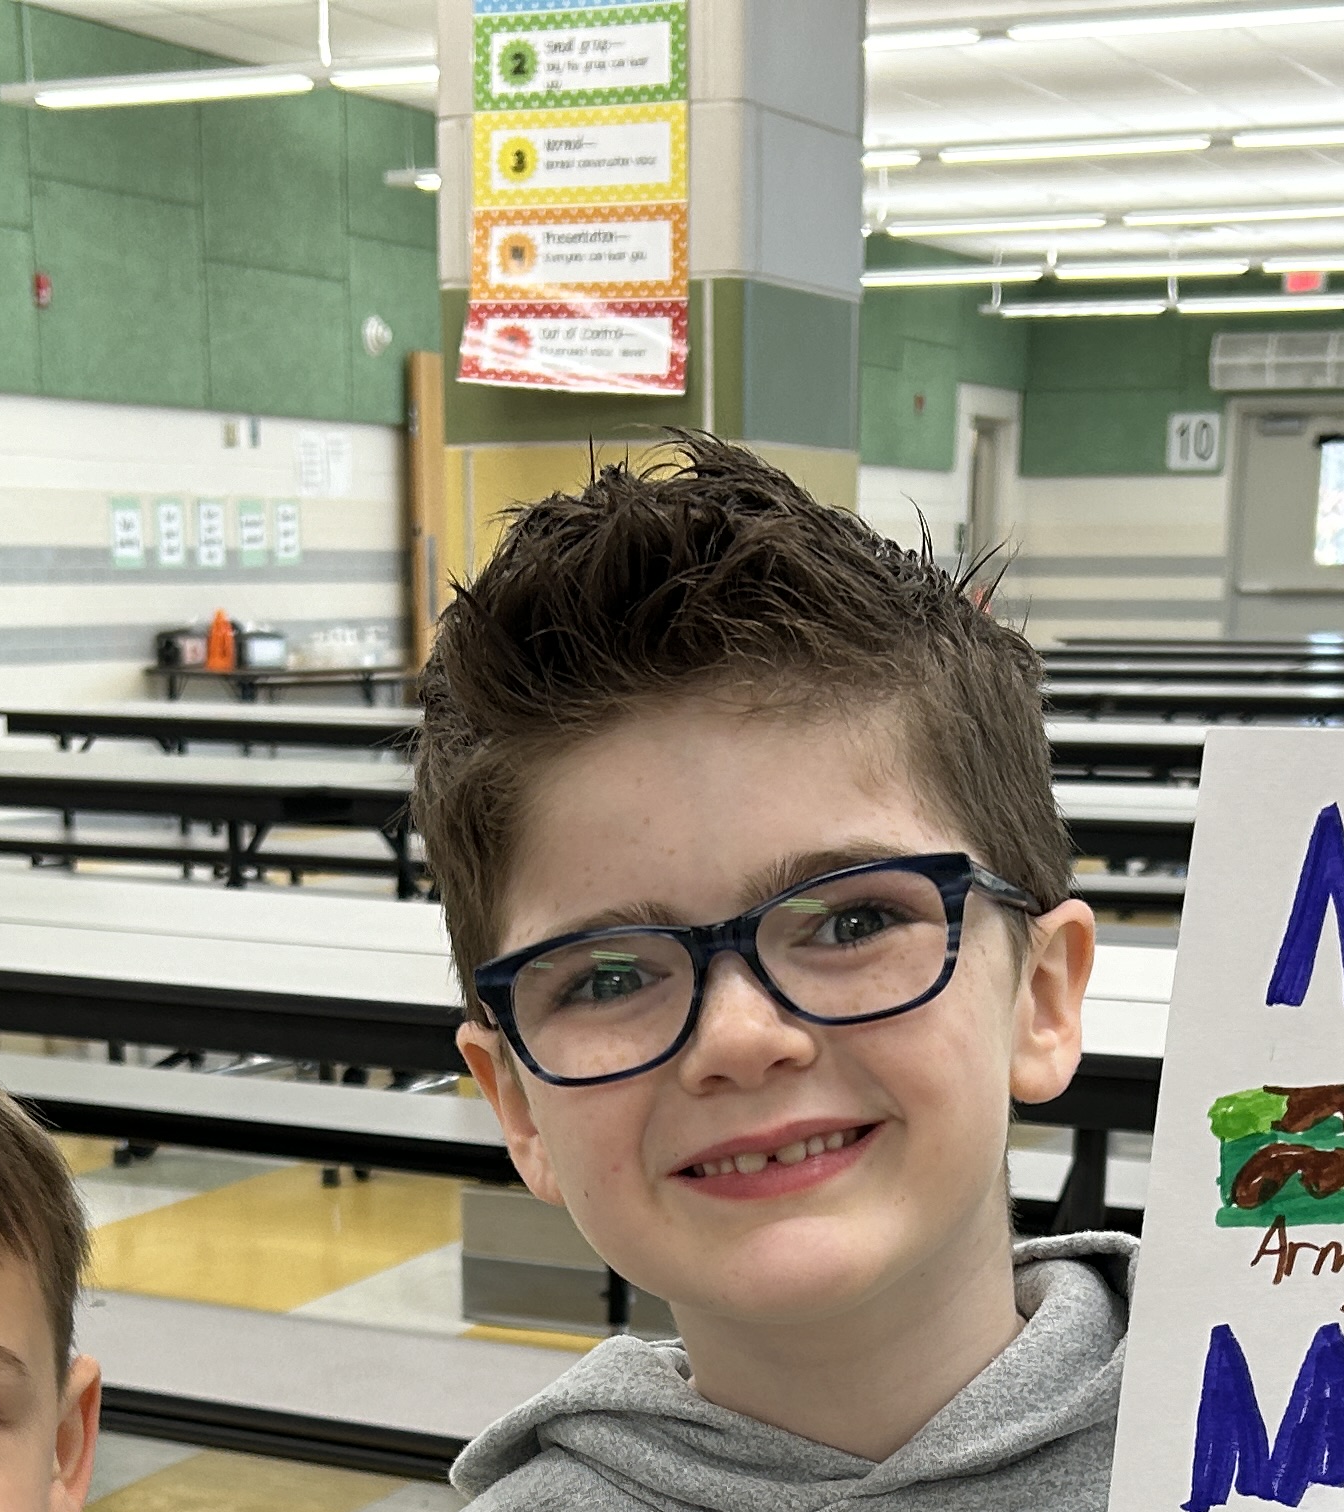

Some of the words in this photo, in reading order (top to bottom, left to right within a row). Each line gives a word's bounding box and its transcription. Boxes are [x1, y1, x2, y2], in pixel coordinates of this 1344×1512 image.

[511, 51, 527, 75] 2
[511, 149, 526, 173] 3
[1177, 420, 1215, 461] 10
